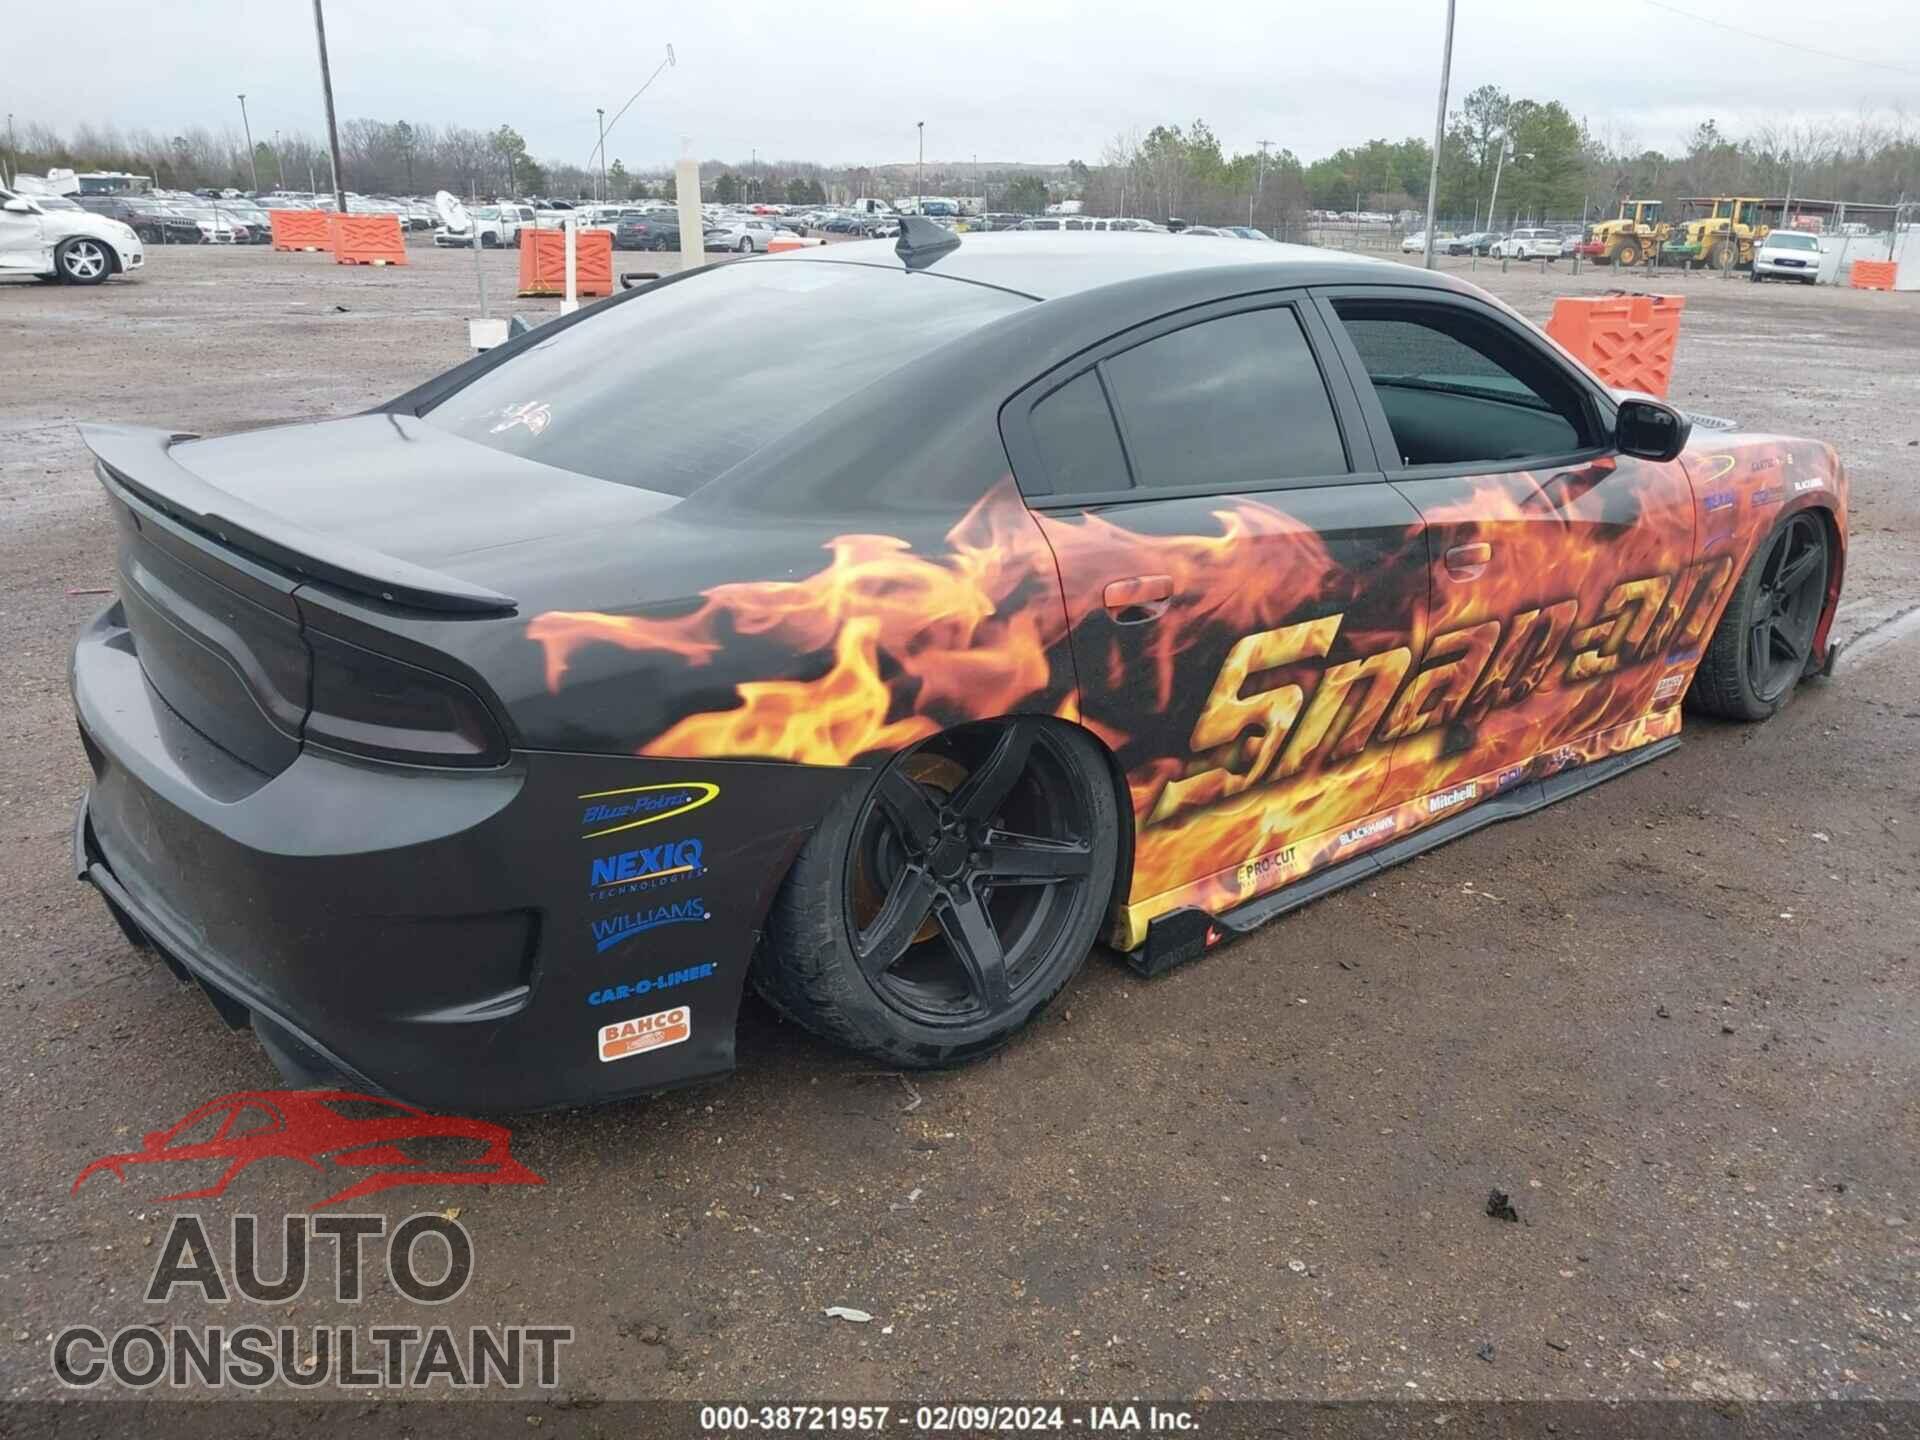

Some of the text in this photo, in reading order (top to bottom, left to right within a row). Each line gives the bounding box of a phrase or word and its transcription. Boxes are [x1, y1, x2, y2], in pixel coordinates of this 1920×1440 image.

[1339, 815, 1395, 846] BLACKHAWK
[591, 838, 704, 887] NEXIQ
[1246, 847, 1296, 878] PRO-CUT
[591, 897, 704, 940] WILLIAMS
[588, 963, 713, 1006] CAR-O-LINER
[605, 1010, 684, 1042] BAHCO
